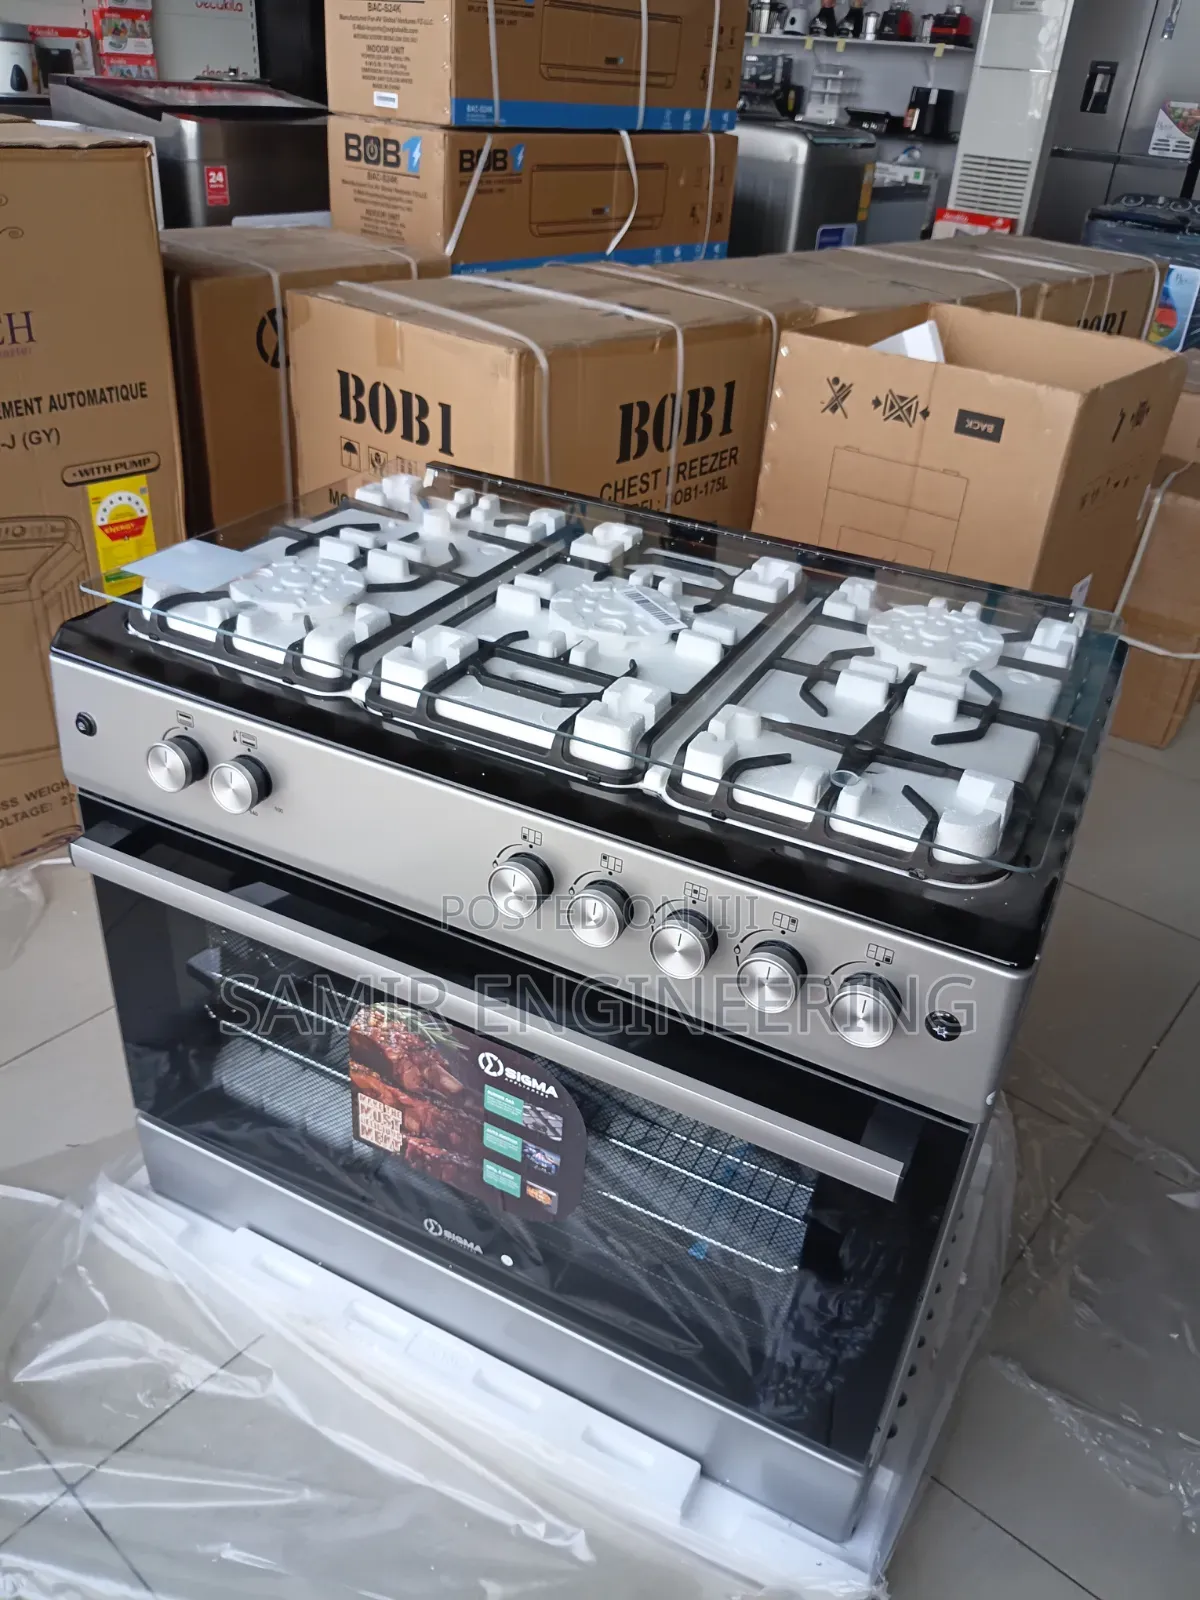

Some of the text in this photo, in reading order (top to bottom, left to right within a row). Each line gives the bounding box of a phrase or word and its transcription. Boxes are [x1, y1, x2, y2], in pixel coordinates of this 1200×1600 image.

[344, 132, 422, 174] BOB1
[208, 171, 224, 184] 24
[0, 311, 36, 345] H
[0, 381, 148, 419] MENT AUTOMATIQUE
[23, 427, 61, 450] (GY)
[965, 418, 995, 433] BACK
[77, 457, 151, 478] WITH PUMP
[600, 468, 662, 502] CHEST
[664, 476, 729, 510] OB1-175L
[505, 1067, 558, 1098] SIGMA
[443, 1229, 483, 1254] SIGMA
